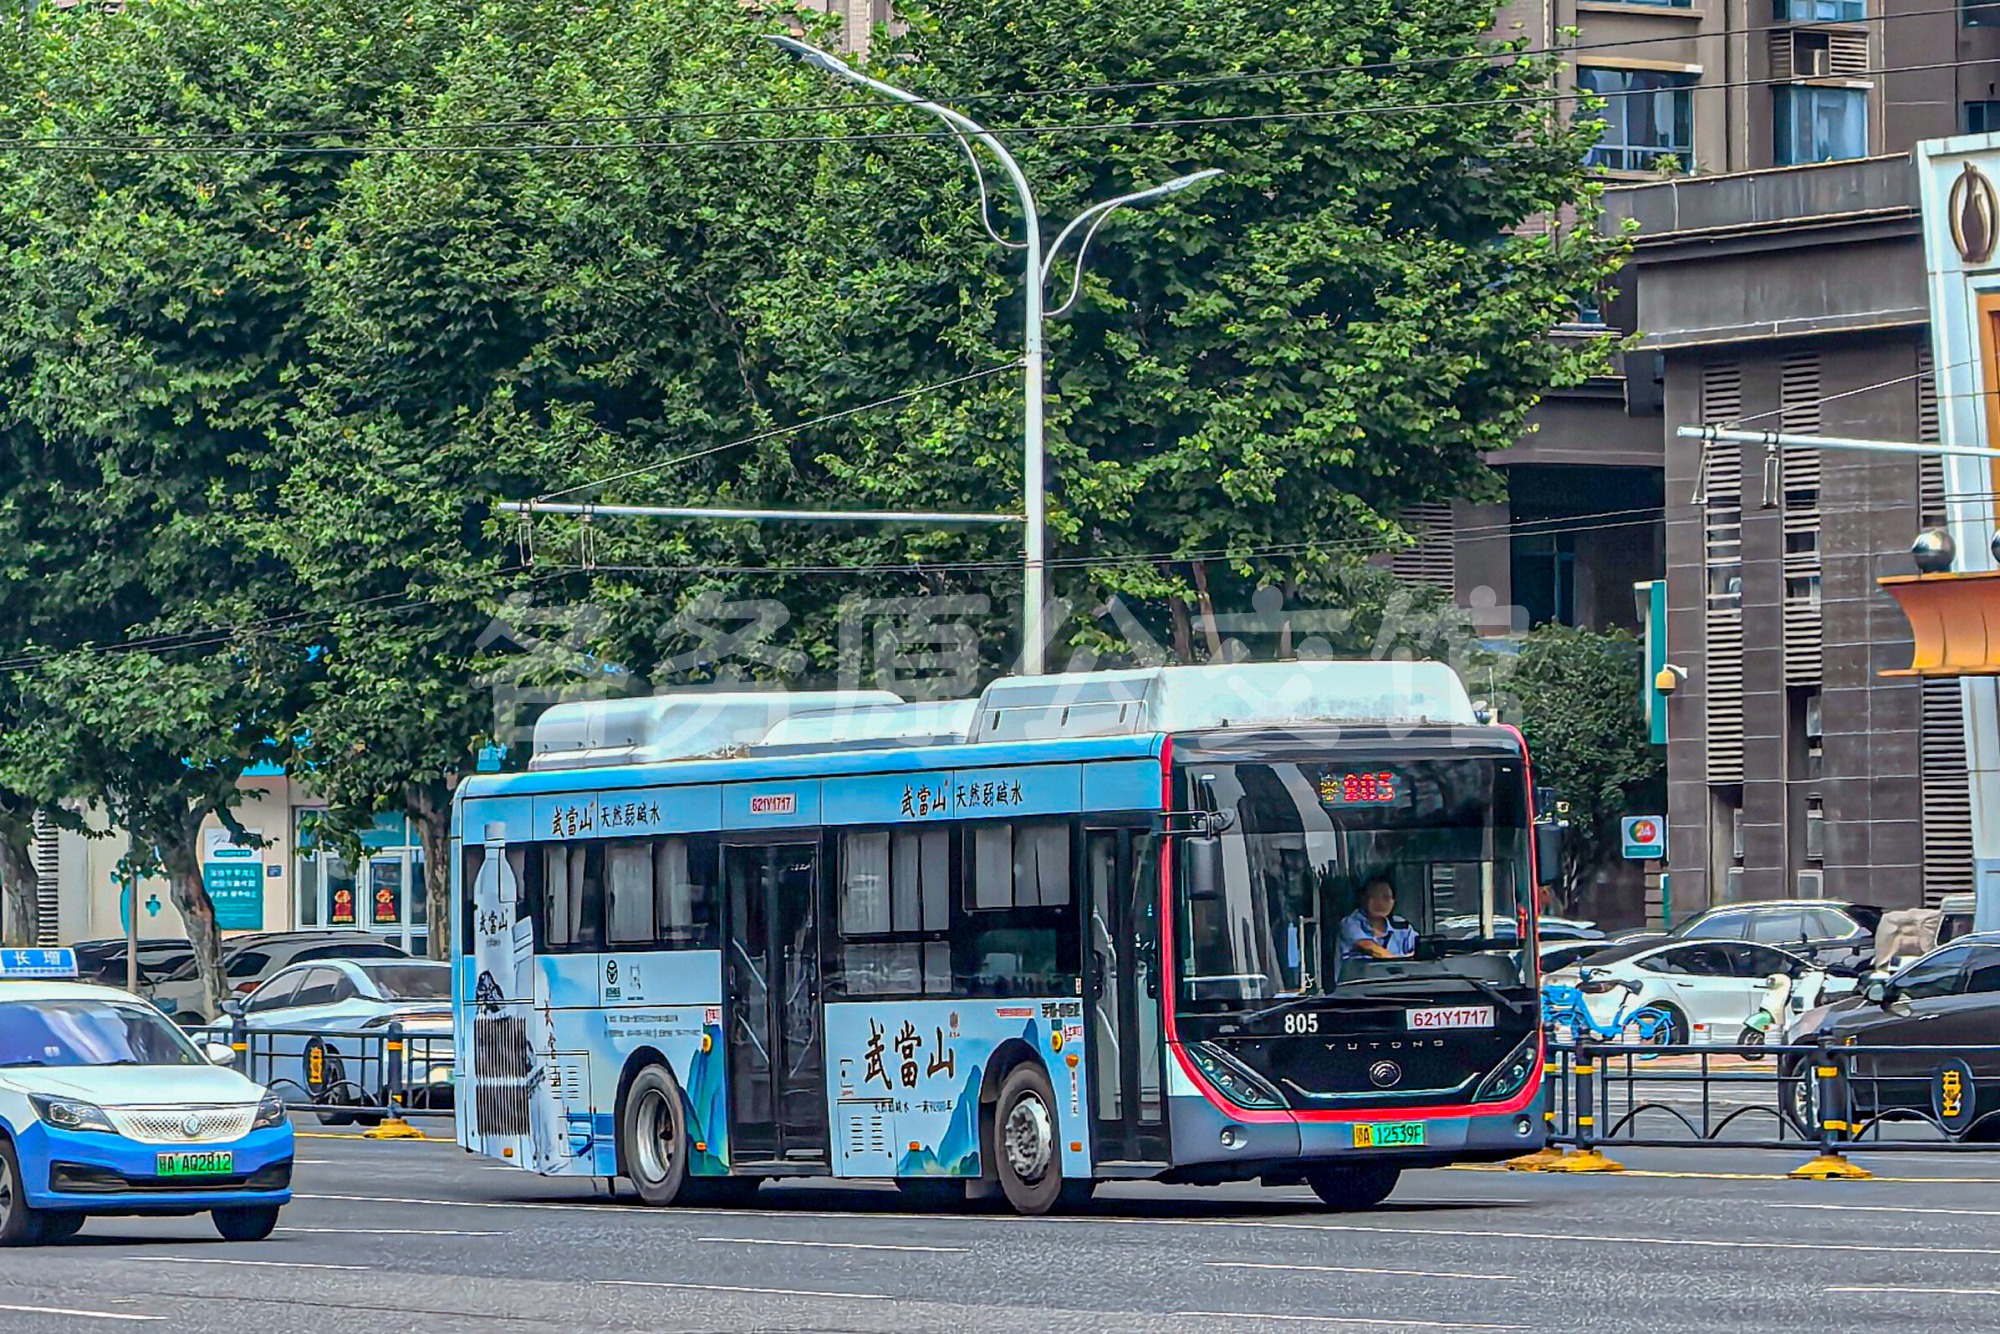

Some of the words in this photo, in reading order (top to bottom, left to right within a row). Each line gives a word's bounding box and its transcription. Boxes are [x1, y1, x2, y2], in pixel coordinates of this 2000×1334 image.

[1283, 1012, 1319, 1035] 805
[1413, 1009, 1489, 1027] 621Y1717
[864, 1016, 955, 1091] 武當山
[1325, 1039, 1444, 1051] YUTONG
